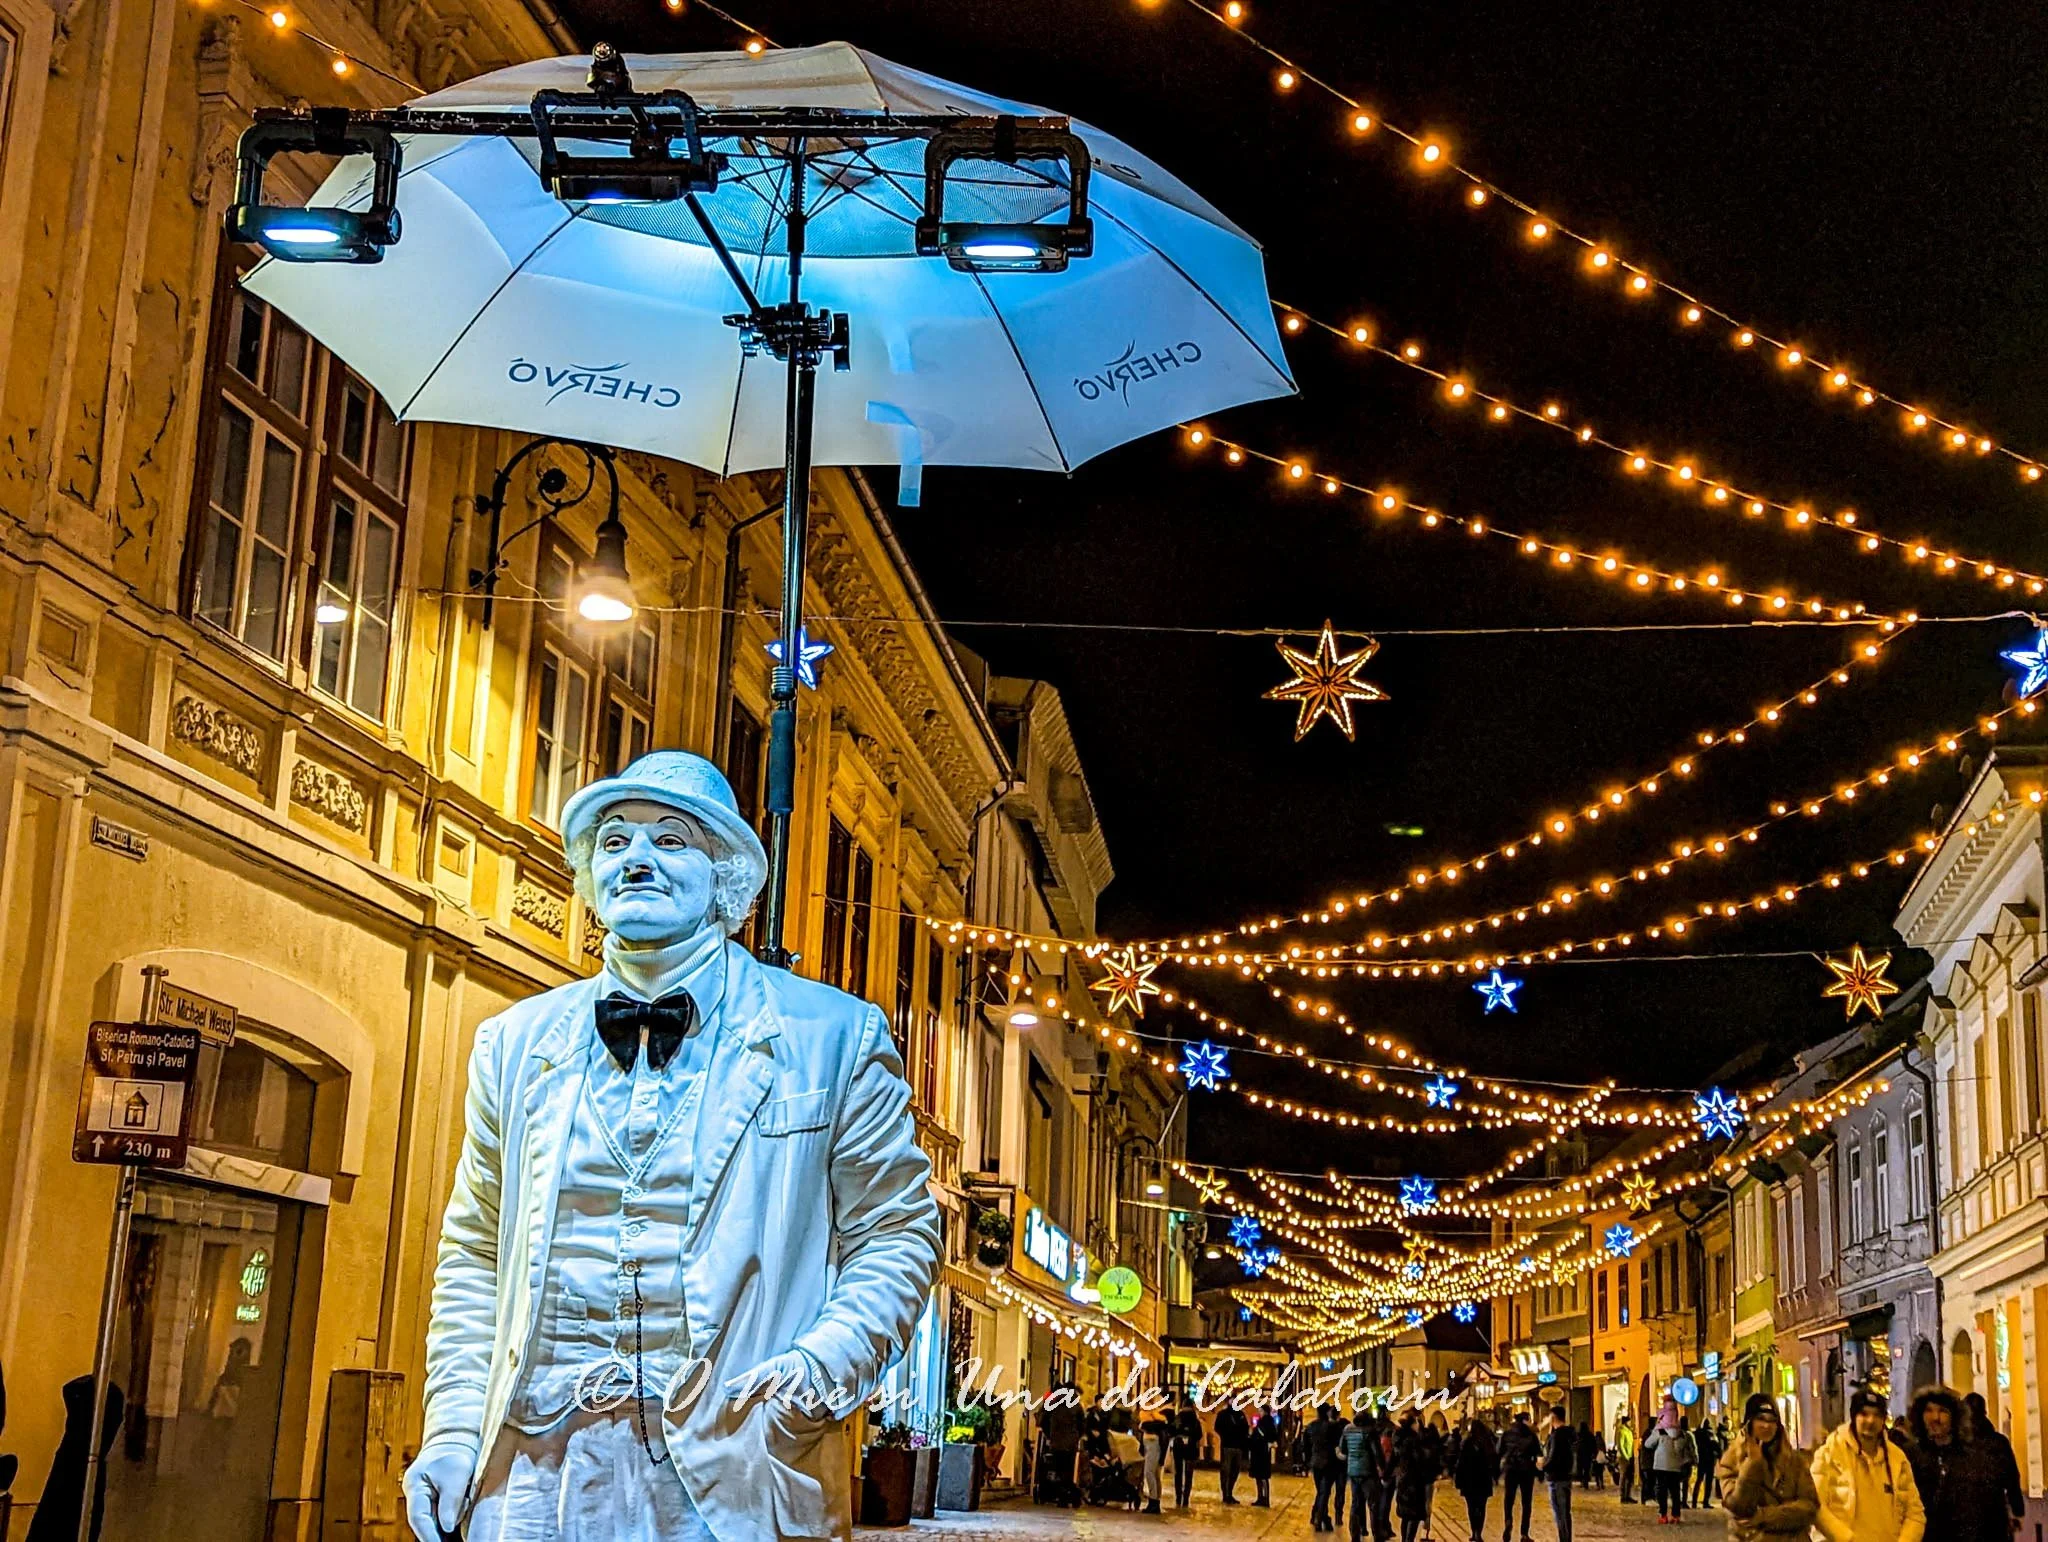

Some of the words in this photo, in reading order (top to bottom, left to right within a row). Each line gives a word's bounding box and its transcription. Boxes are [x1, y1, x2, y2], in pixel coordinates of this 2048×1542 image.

[160, 991, 174, 1017] Str.
[176, 997, 207, 1027] Michael
[208, 1008, 232, 1037] Weiss
[96, 1028, 128, 1044] Biserica
[129, 1030, 196, 1050] Romano-Catolică
[101, 1048, 113, 1063] Sf.
[117, 1050, 145, 1065] Petru
[158, 1052, 187, 1068] Pavel
[124, 1140, 152, 1157] 230
[156, 1147, 171, 1159] m
